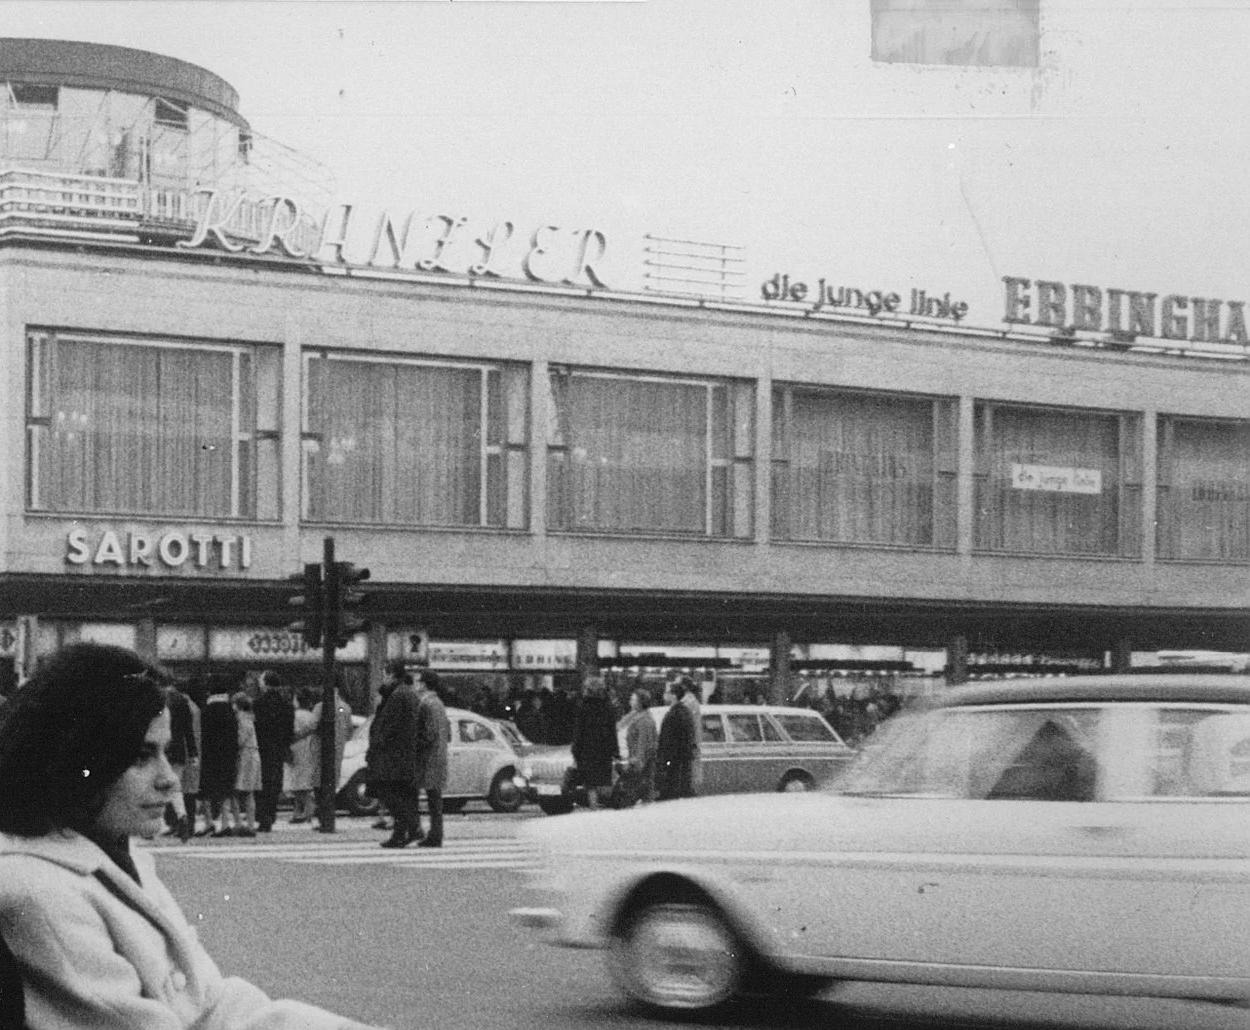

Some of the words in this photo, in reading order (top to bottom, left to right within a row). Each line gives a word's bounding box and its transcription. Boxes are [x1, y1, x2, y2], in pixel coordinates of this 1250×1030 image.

[176, 187, 609, 290] KRANZLER
[761, 273, 808, 301] die
[812, 278, 901, 316] junge
[910, 287, 969, 321] linie
[1001, 275, 1250, 345] EBBINGHA
[66, 528, 250, 568] SAROTTI
